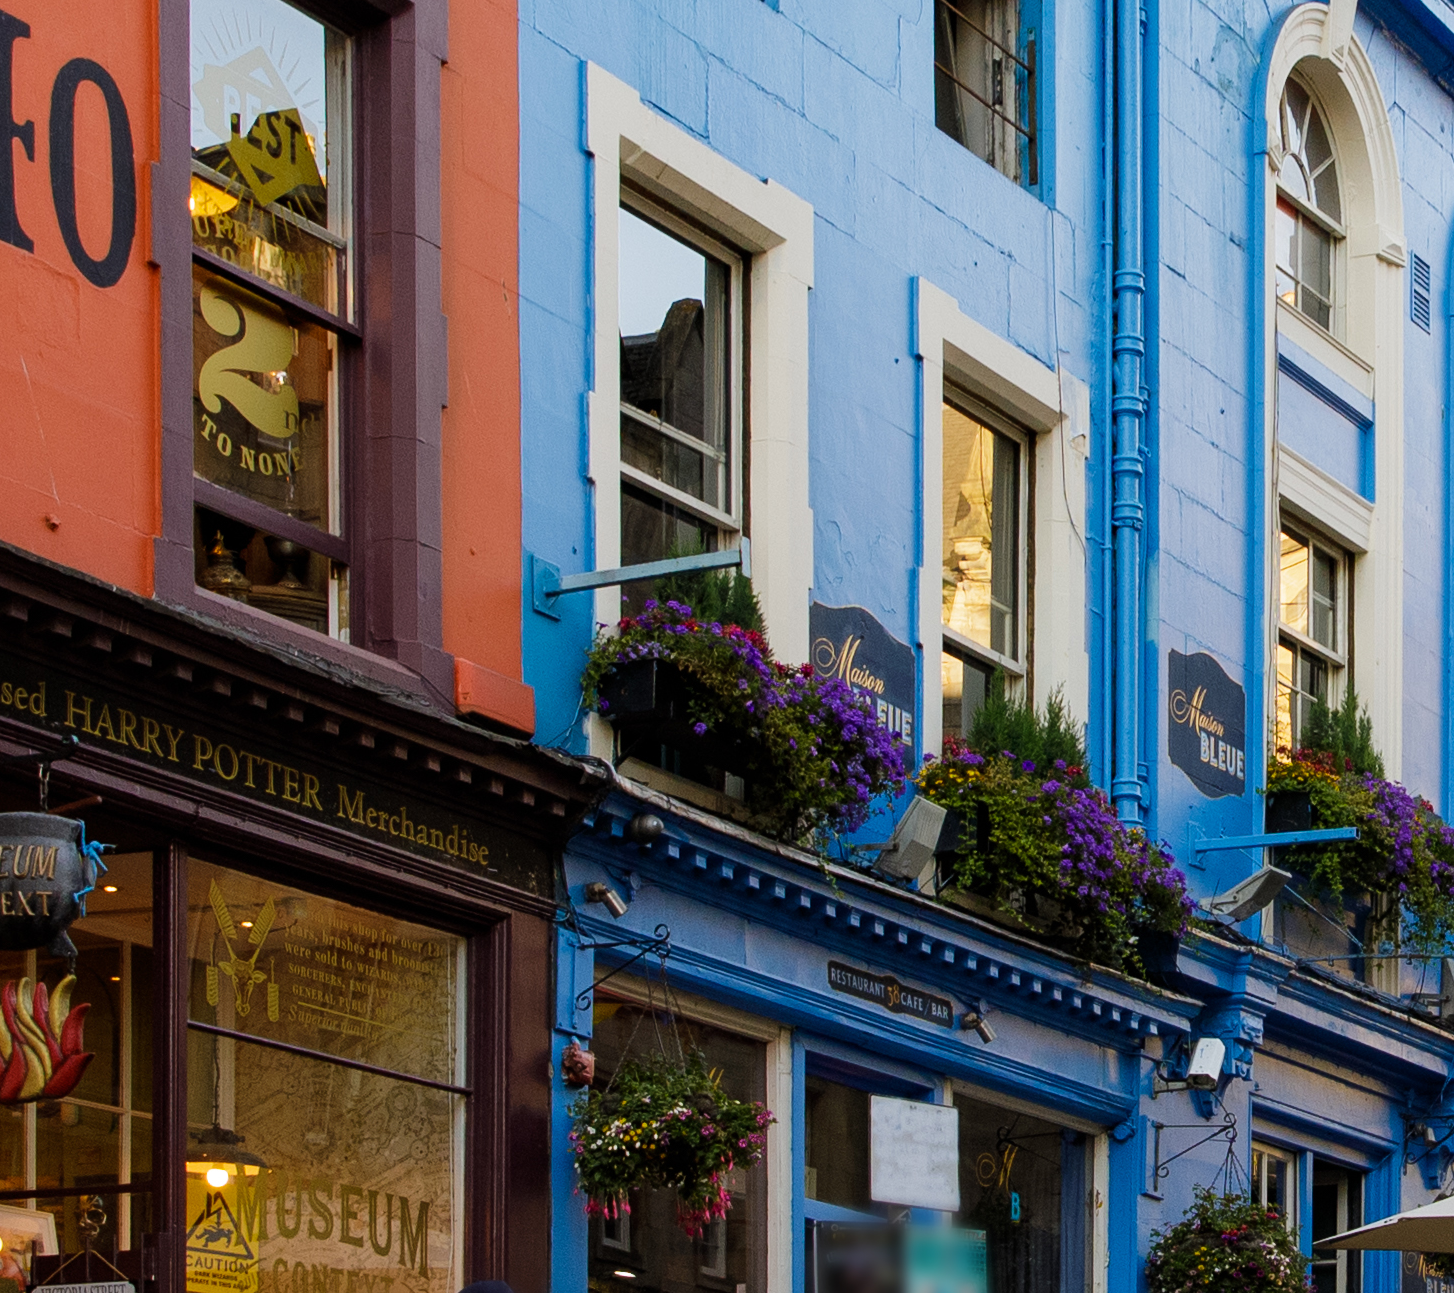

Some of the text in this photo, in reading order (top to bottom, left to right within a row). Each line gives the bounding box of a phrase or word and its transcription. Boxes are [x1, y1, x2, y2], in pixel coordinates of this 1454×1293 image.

[224, 84, 301, 165] BEST
[201, 414, 233, 457] TO
[240, 445, 303, 476] NONE
[811, 634, 885, 695] Maison
[1170, 685, 1225, 736] Maison
[1200, 732, 1245, 780] BLEUE
[64, 690, 182, 763] HARRY
[192, 735, 320, 812] POTTER
[335, 782, 490, 871] Merchandise
[284, 941, 311, 958] were
[315, 949, 338, 967] sold
[342, 955, 353, 971] to
[322, 930, 366, 956] brushes
[368, 947, 388, 962] and
[352, 921, 378, 943] shop
[381, 927, 397, 945] for
[401, 938, 424, 955] over
[288, 962, 346, 991] SORCERERS,
[292, 984, 336, 1006] GENERAL
[831, 968, 949, 1020] RESTAURANT 38 CAFE BAR
[234, 1163, 431, 1282] MUSEUM
[186, 1255, 249, 1275] CAUTION
[186, 1277, 210, 1285] PERATE
